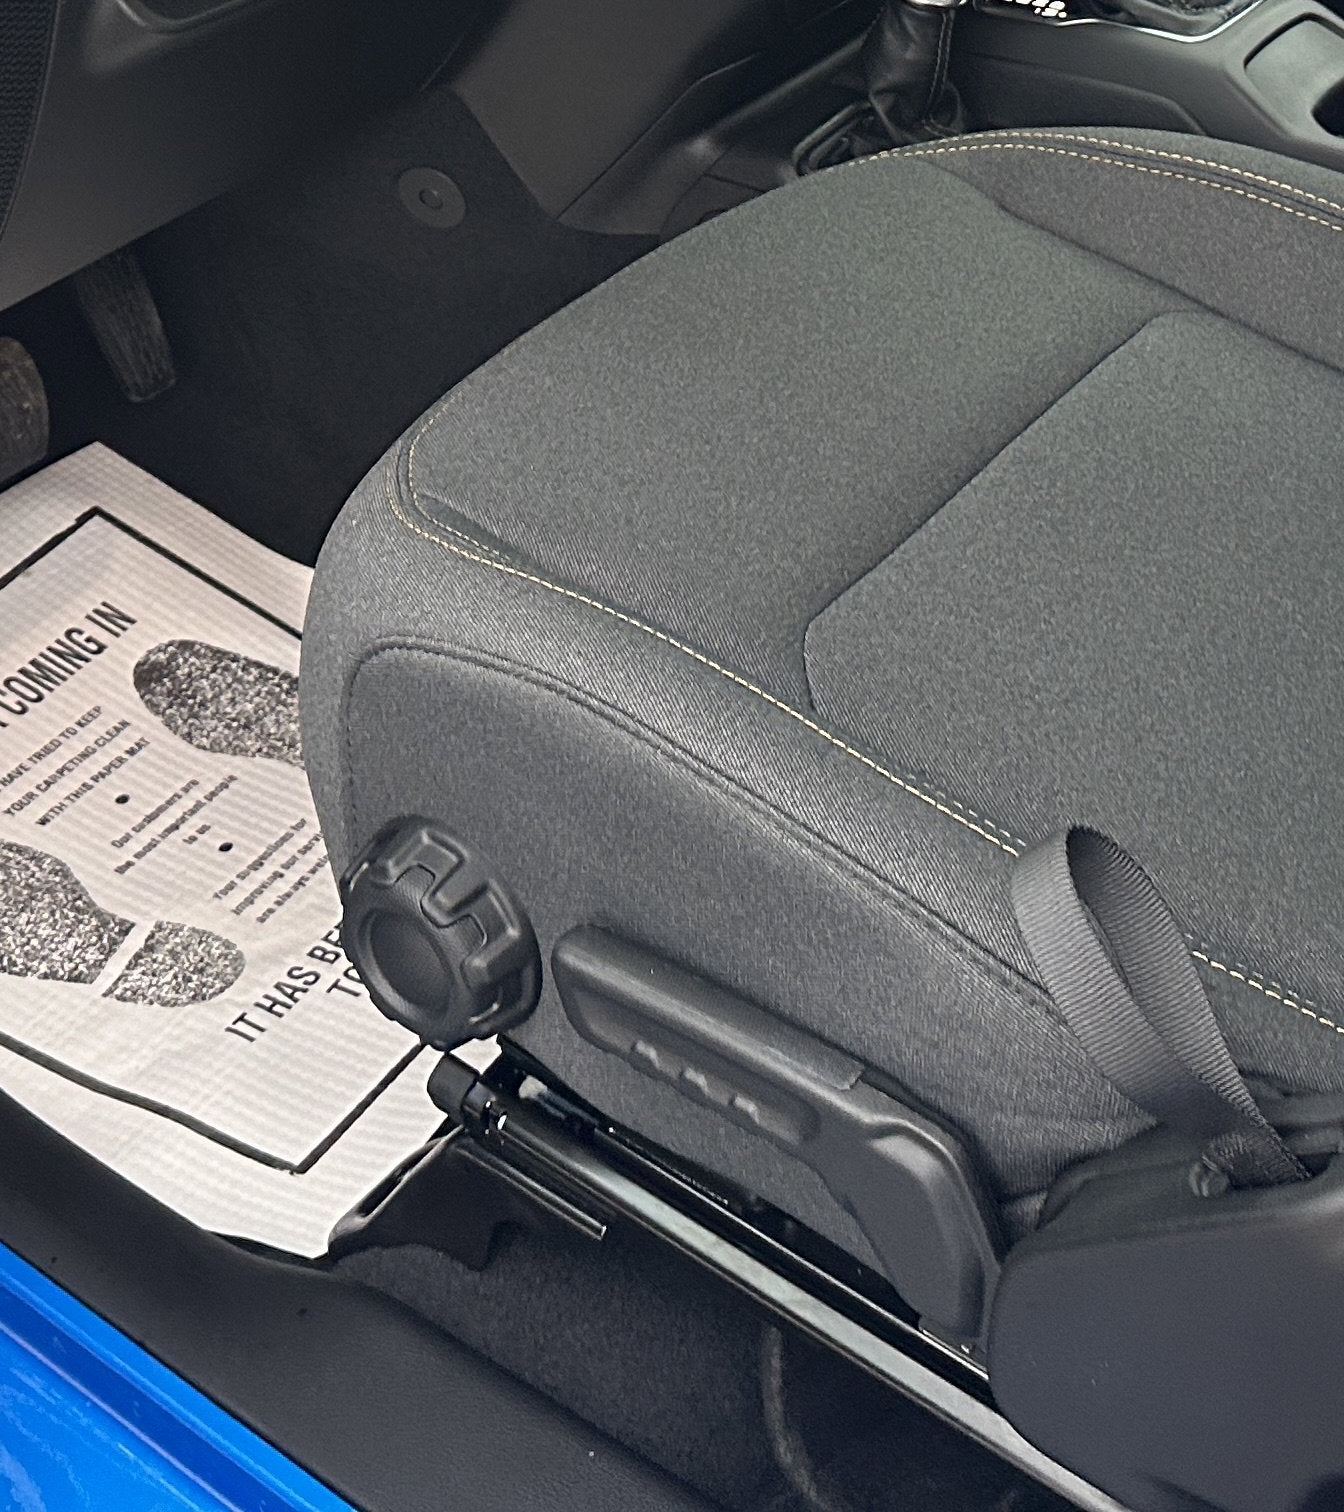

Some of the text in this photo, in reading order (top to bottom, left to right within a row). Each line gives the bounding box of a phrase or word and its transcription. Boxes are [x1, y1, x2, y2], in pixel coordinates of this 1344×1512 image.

[84, 600, 138, 639] IN
[2, 719, 131, 817] YOUR CARPETING CLEAN
[27, 738, 63, 765] TRIED
[58, 726, 78, 740] TO
[74, 705, 103, 728] KEEP
[35, 736, 151, 826] WITH THIS PAPER MAT
[224, 1011, 267, 1043] IT
[253, 965, 322, 1019] HAS
